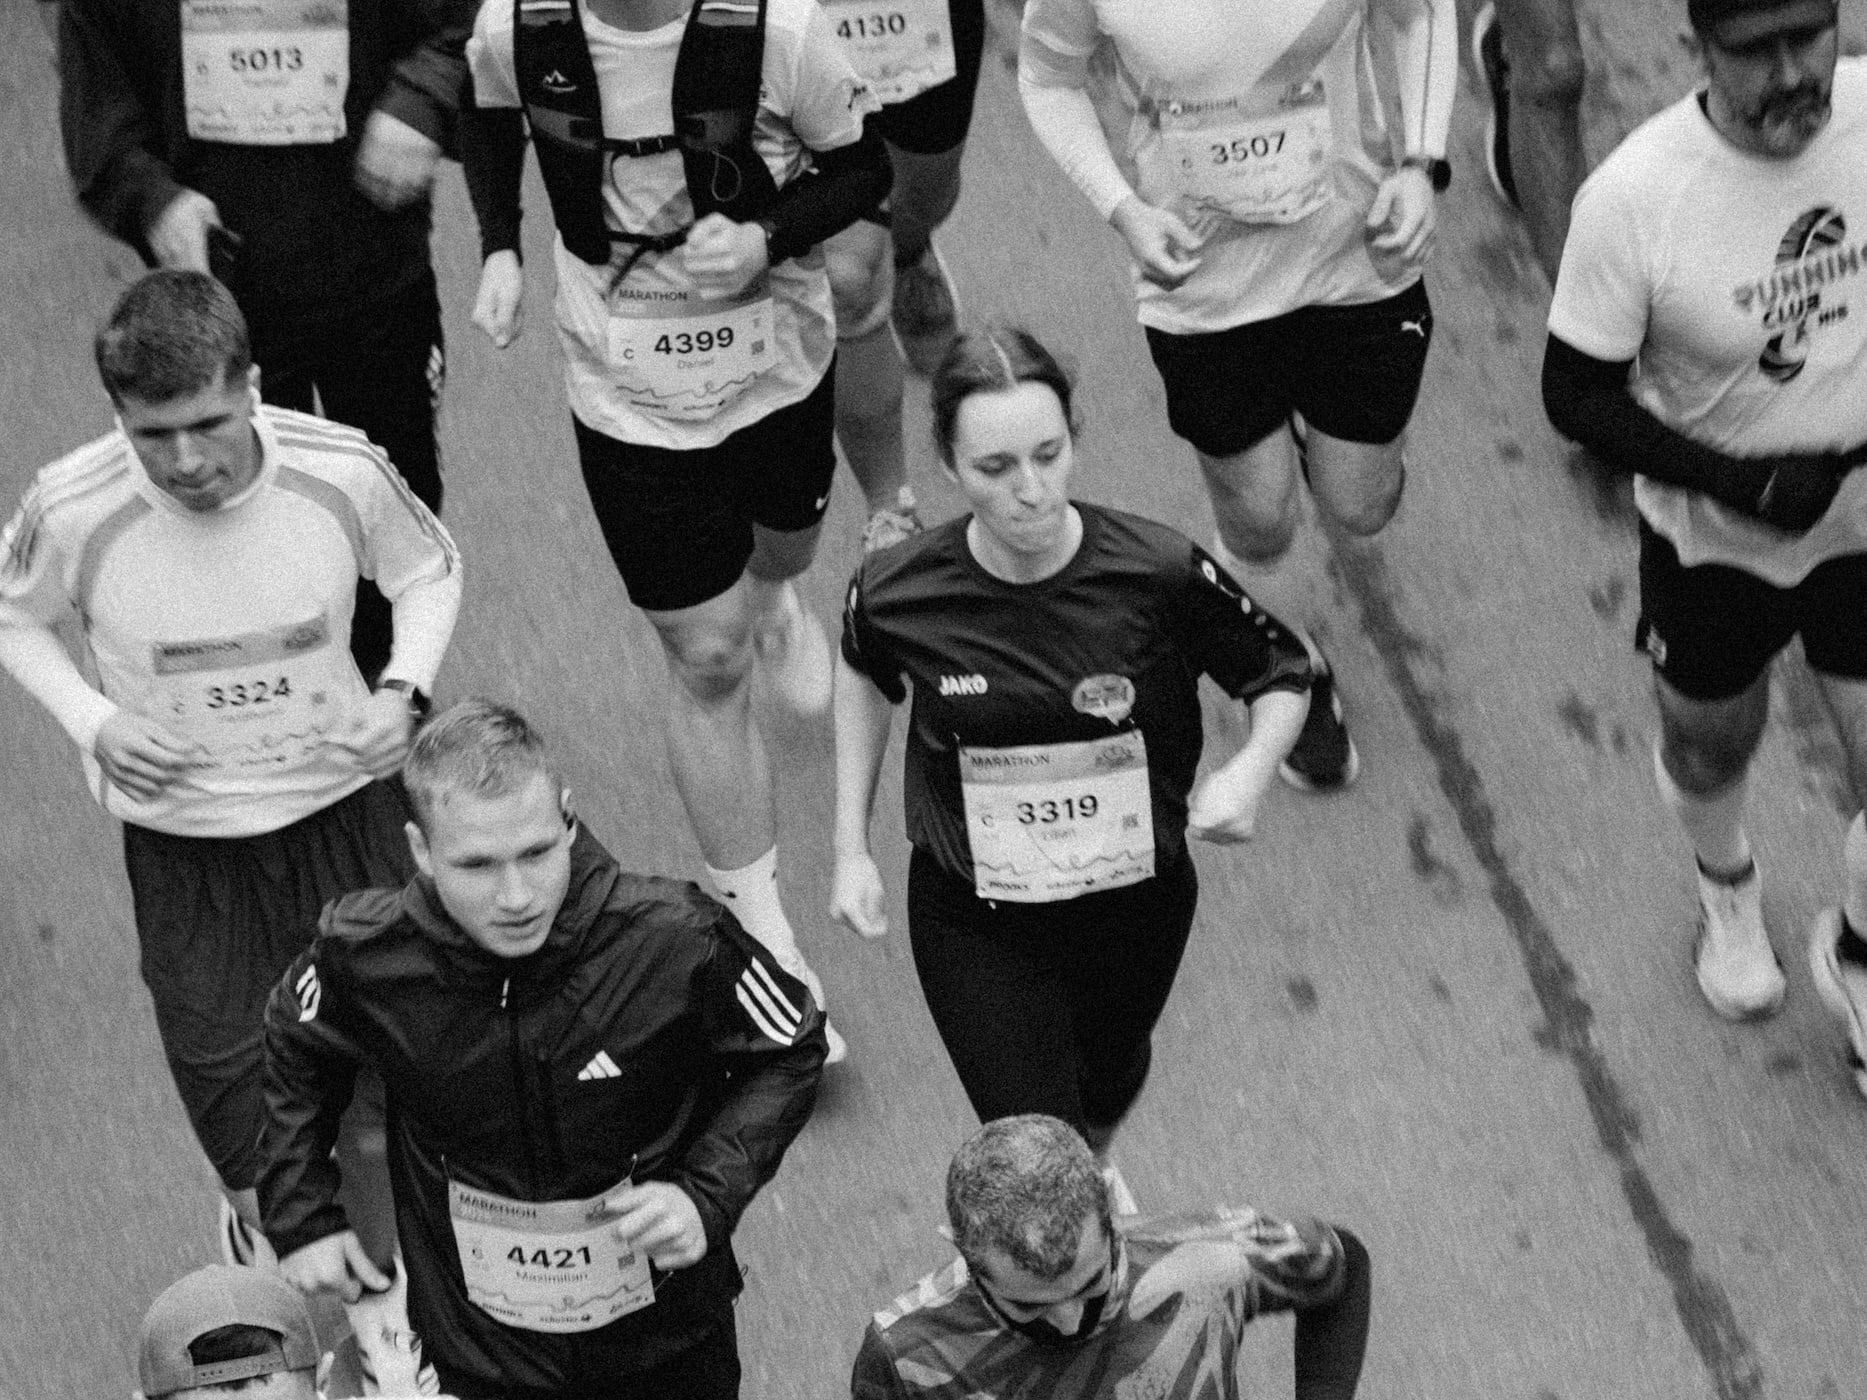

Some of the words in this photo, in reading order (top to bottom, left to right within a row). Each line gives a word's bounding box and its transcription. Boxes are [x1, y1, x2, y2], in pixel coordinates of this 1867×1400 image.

[837, 13, 905, 39] 4130
[230, 48, 303, 72] 5013
[1211, 131, 1286, 164] 3507
[1734, 243, 1867, 312] RUNNIN
[618, 289, 688, 301] MARATHON
[654, 327, 734, 355] 4399
[623, 348, 634, 360] C
[206, 677, 293, 709] 3324
[939, 673, 988, 696] JAKO
[970, 754, 1050, 768] MARATHON
[981, 814, 994, 827] C
[1017, 795, 1098, 825] 3319
[459, 1193, 537, 1219] MARATHON
[507, 1246, 591, 1269] 4421
